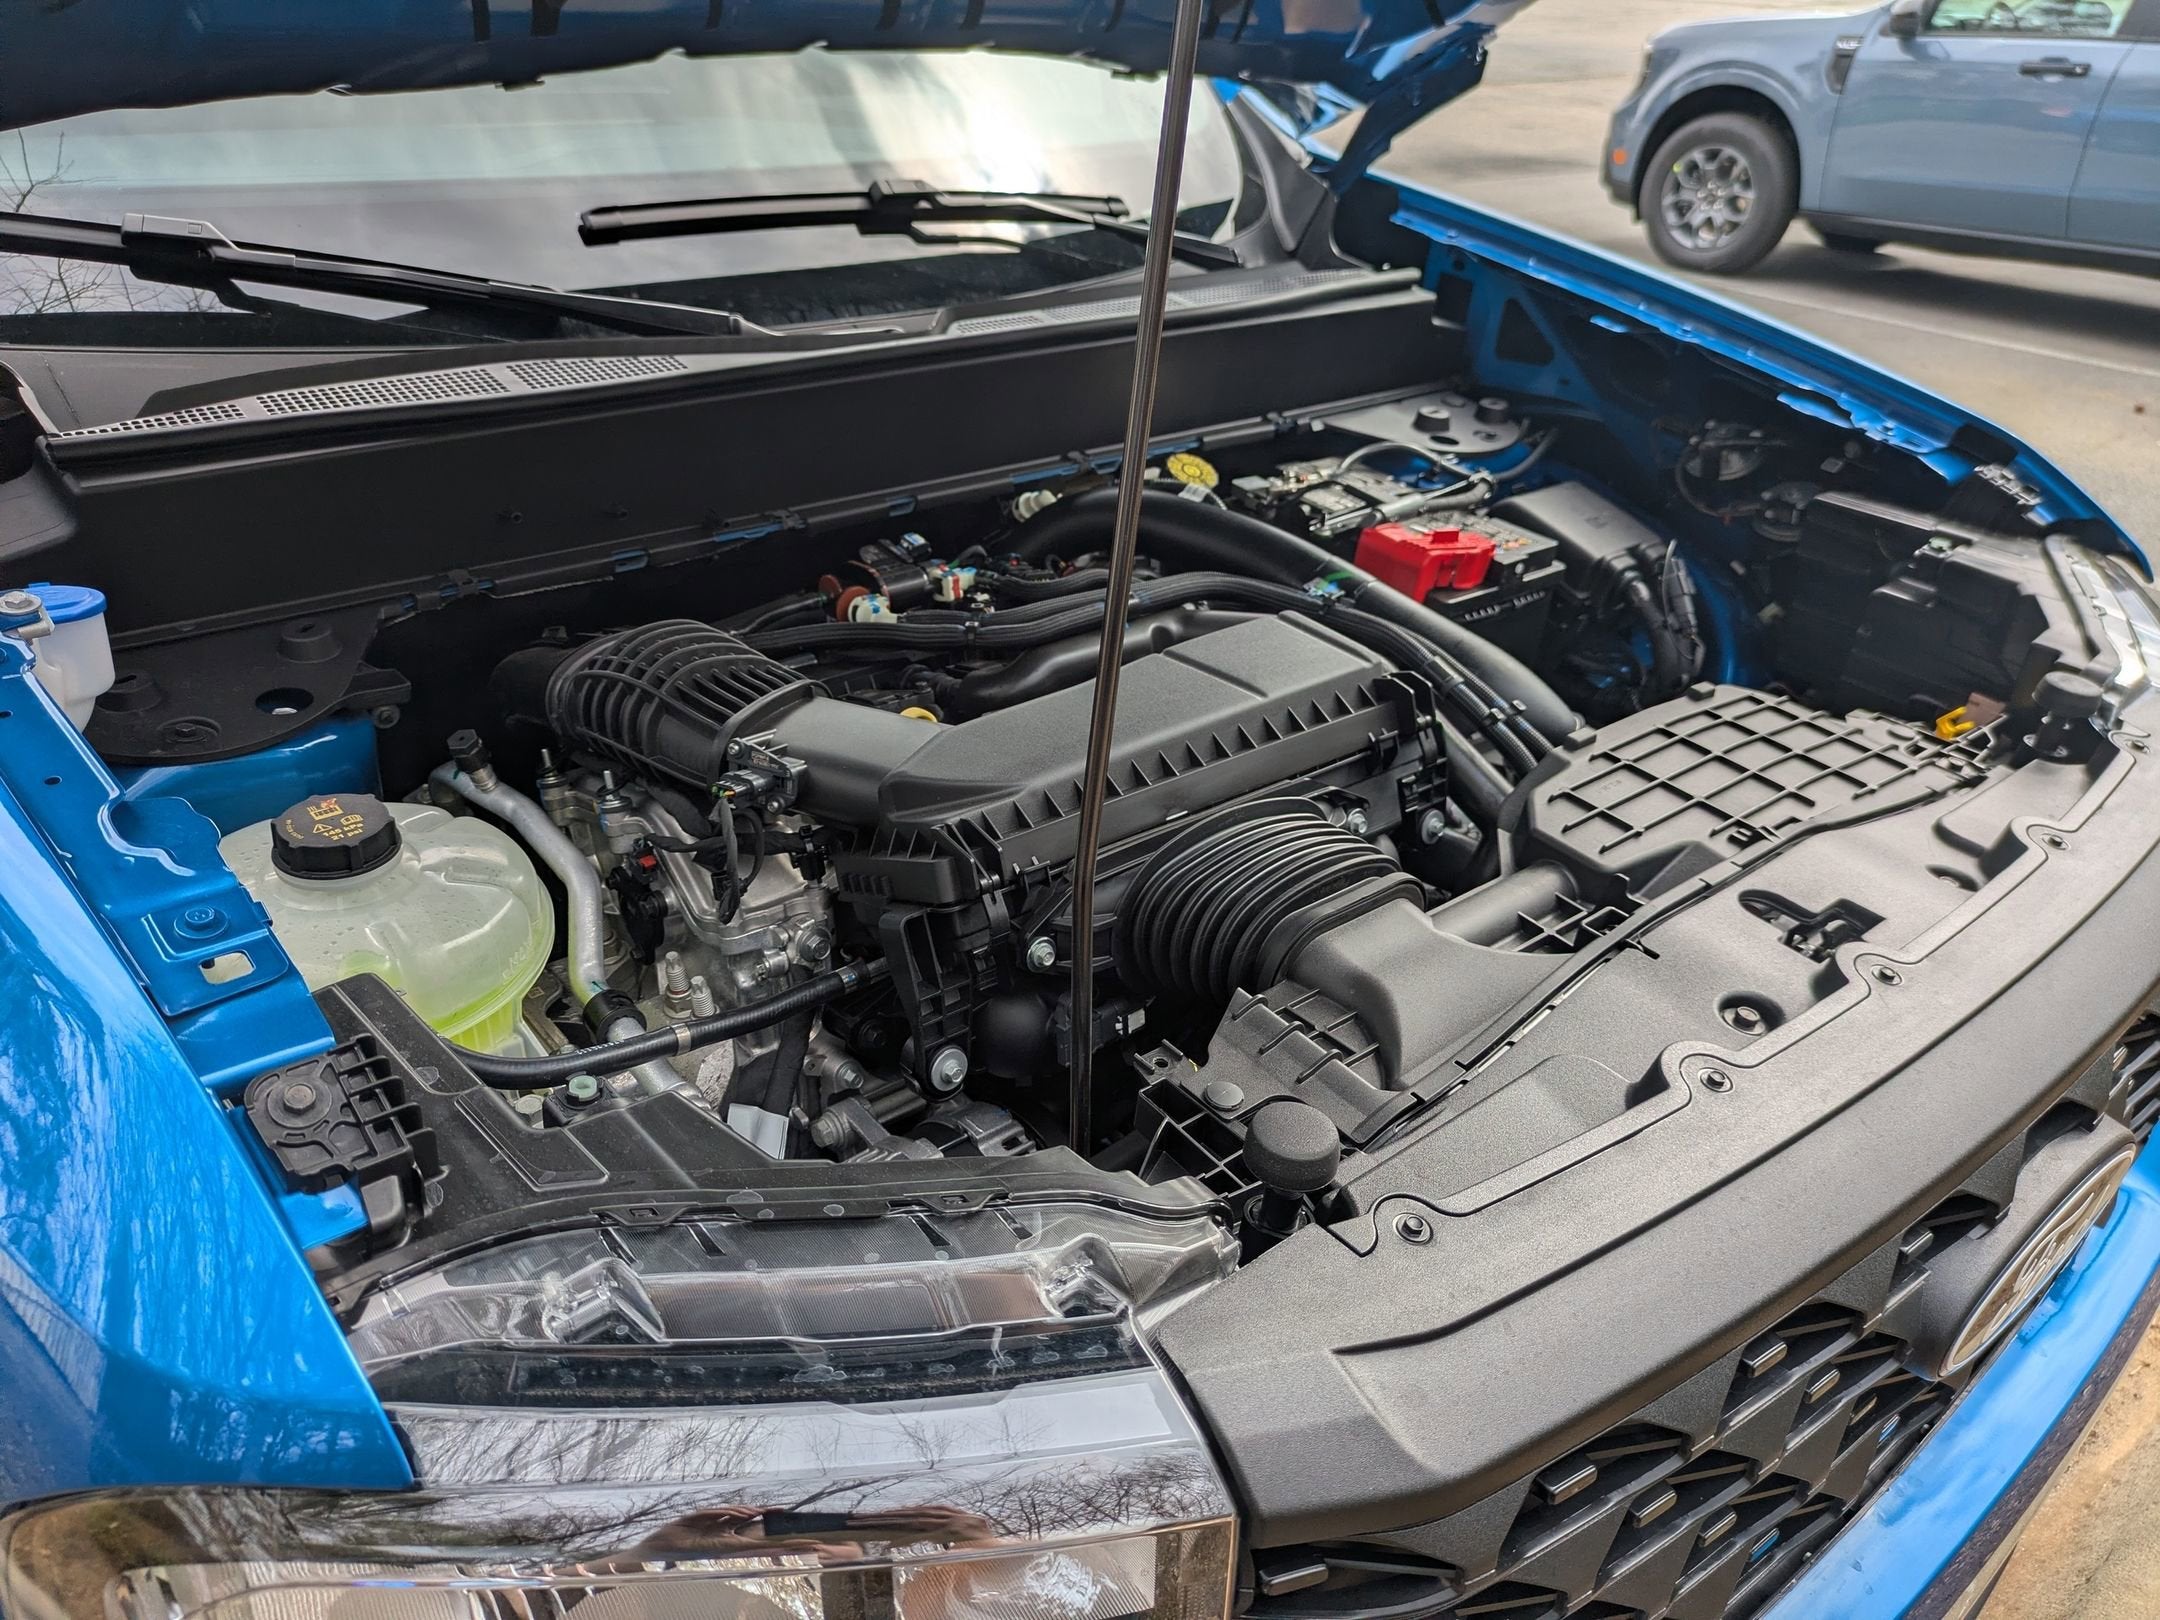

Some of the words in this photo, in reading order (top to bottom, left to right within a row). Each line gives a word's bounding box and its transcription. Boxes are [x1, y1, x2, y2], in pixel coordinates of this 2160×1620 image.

[322, 828, 342, 837] 145
[331, 833, 344, 841] 21
[347, 828, 363, 837] psi
